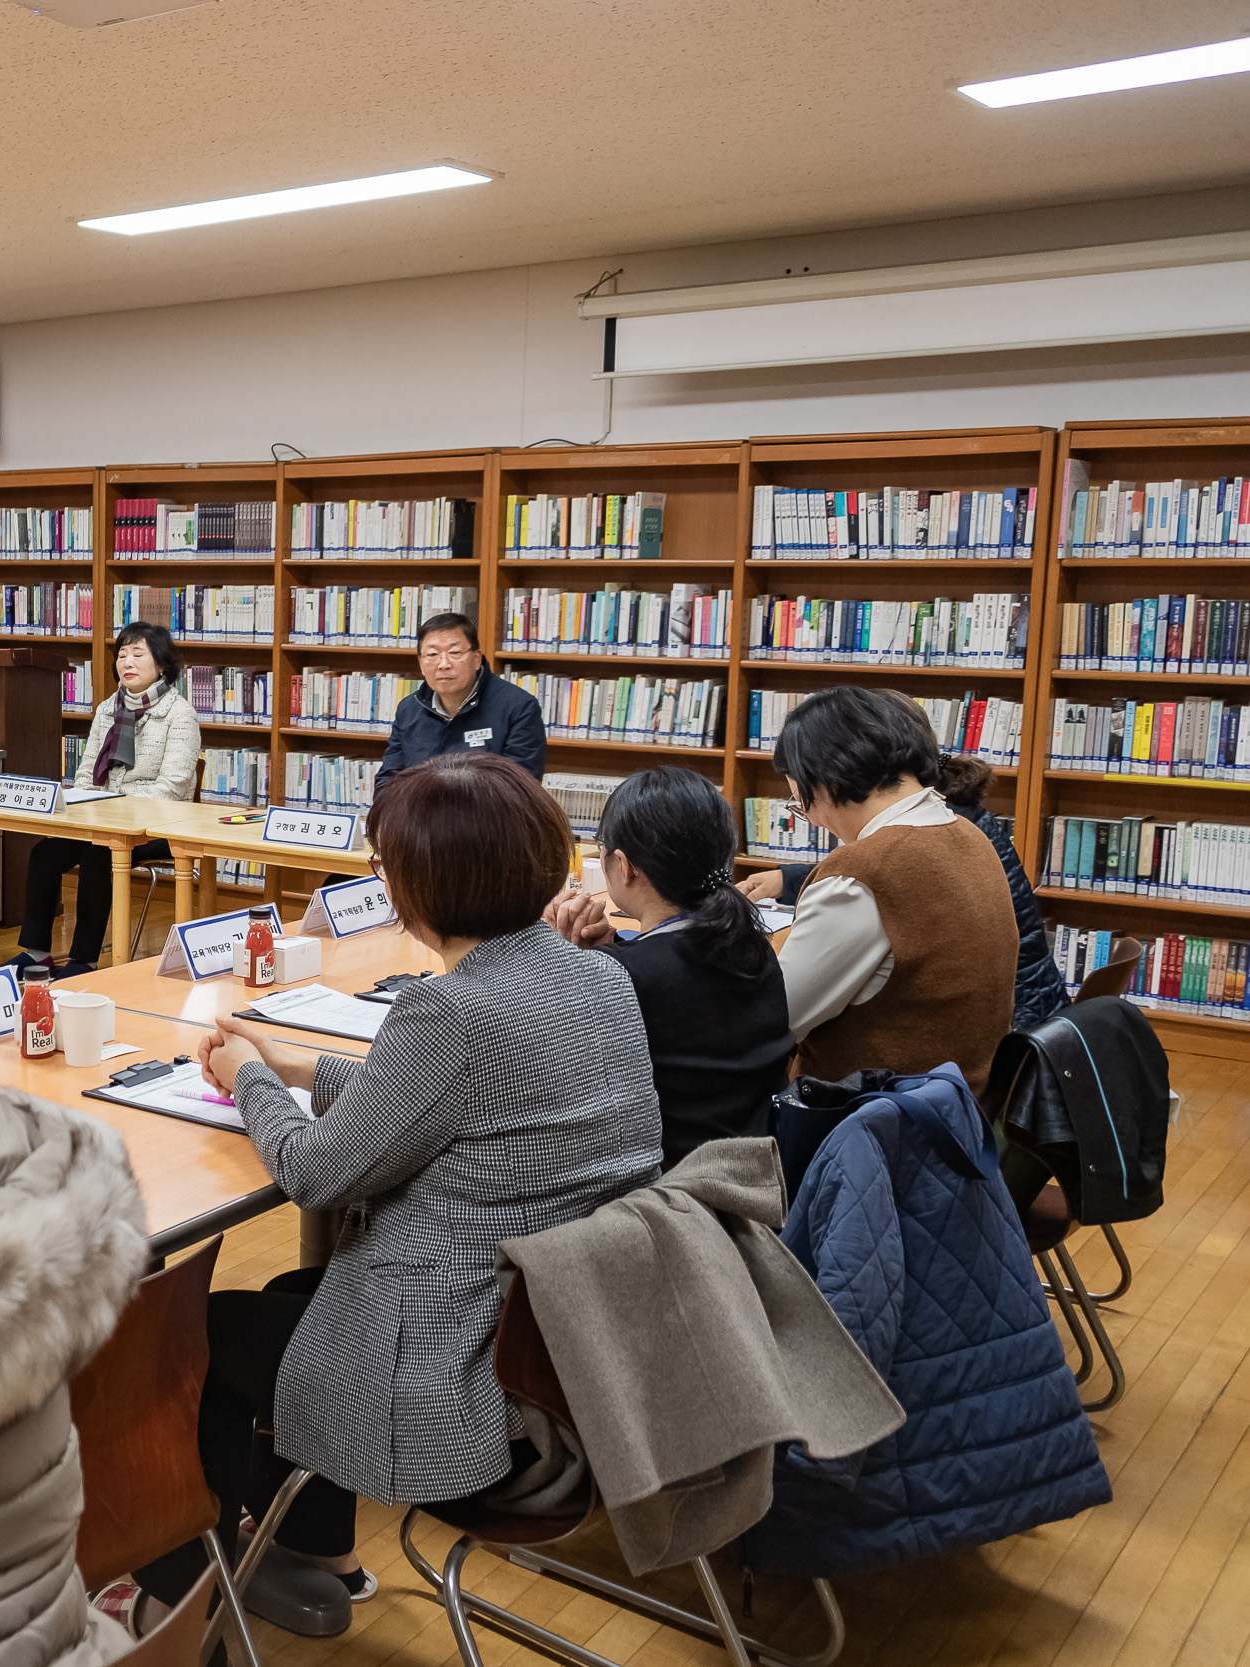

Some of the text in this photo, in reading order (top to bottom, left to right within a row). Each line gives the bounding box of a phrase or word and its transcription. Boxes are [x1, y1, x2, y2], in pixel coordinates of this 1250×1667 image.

[3, 782, 47, 793] 서울장안초등학교
[275, 822, 296, 832] 구청장
[261, 969, 274, 978] Rea
[31, 1030, 44, 1038] I'm
[32, 1034, 54, 1048] Real
